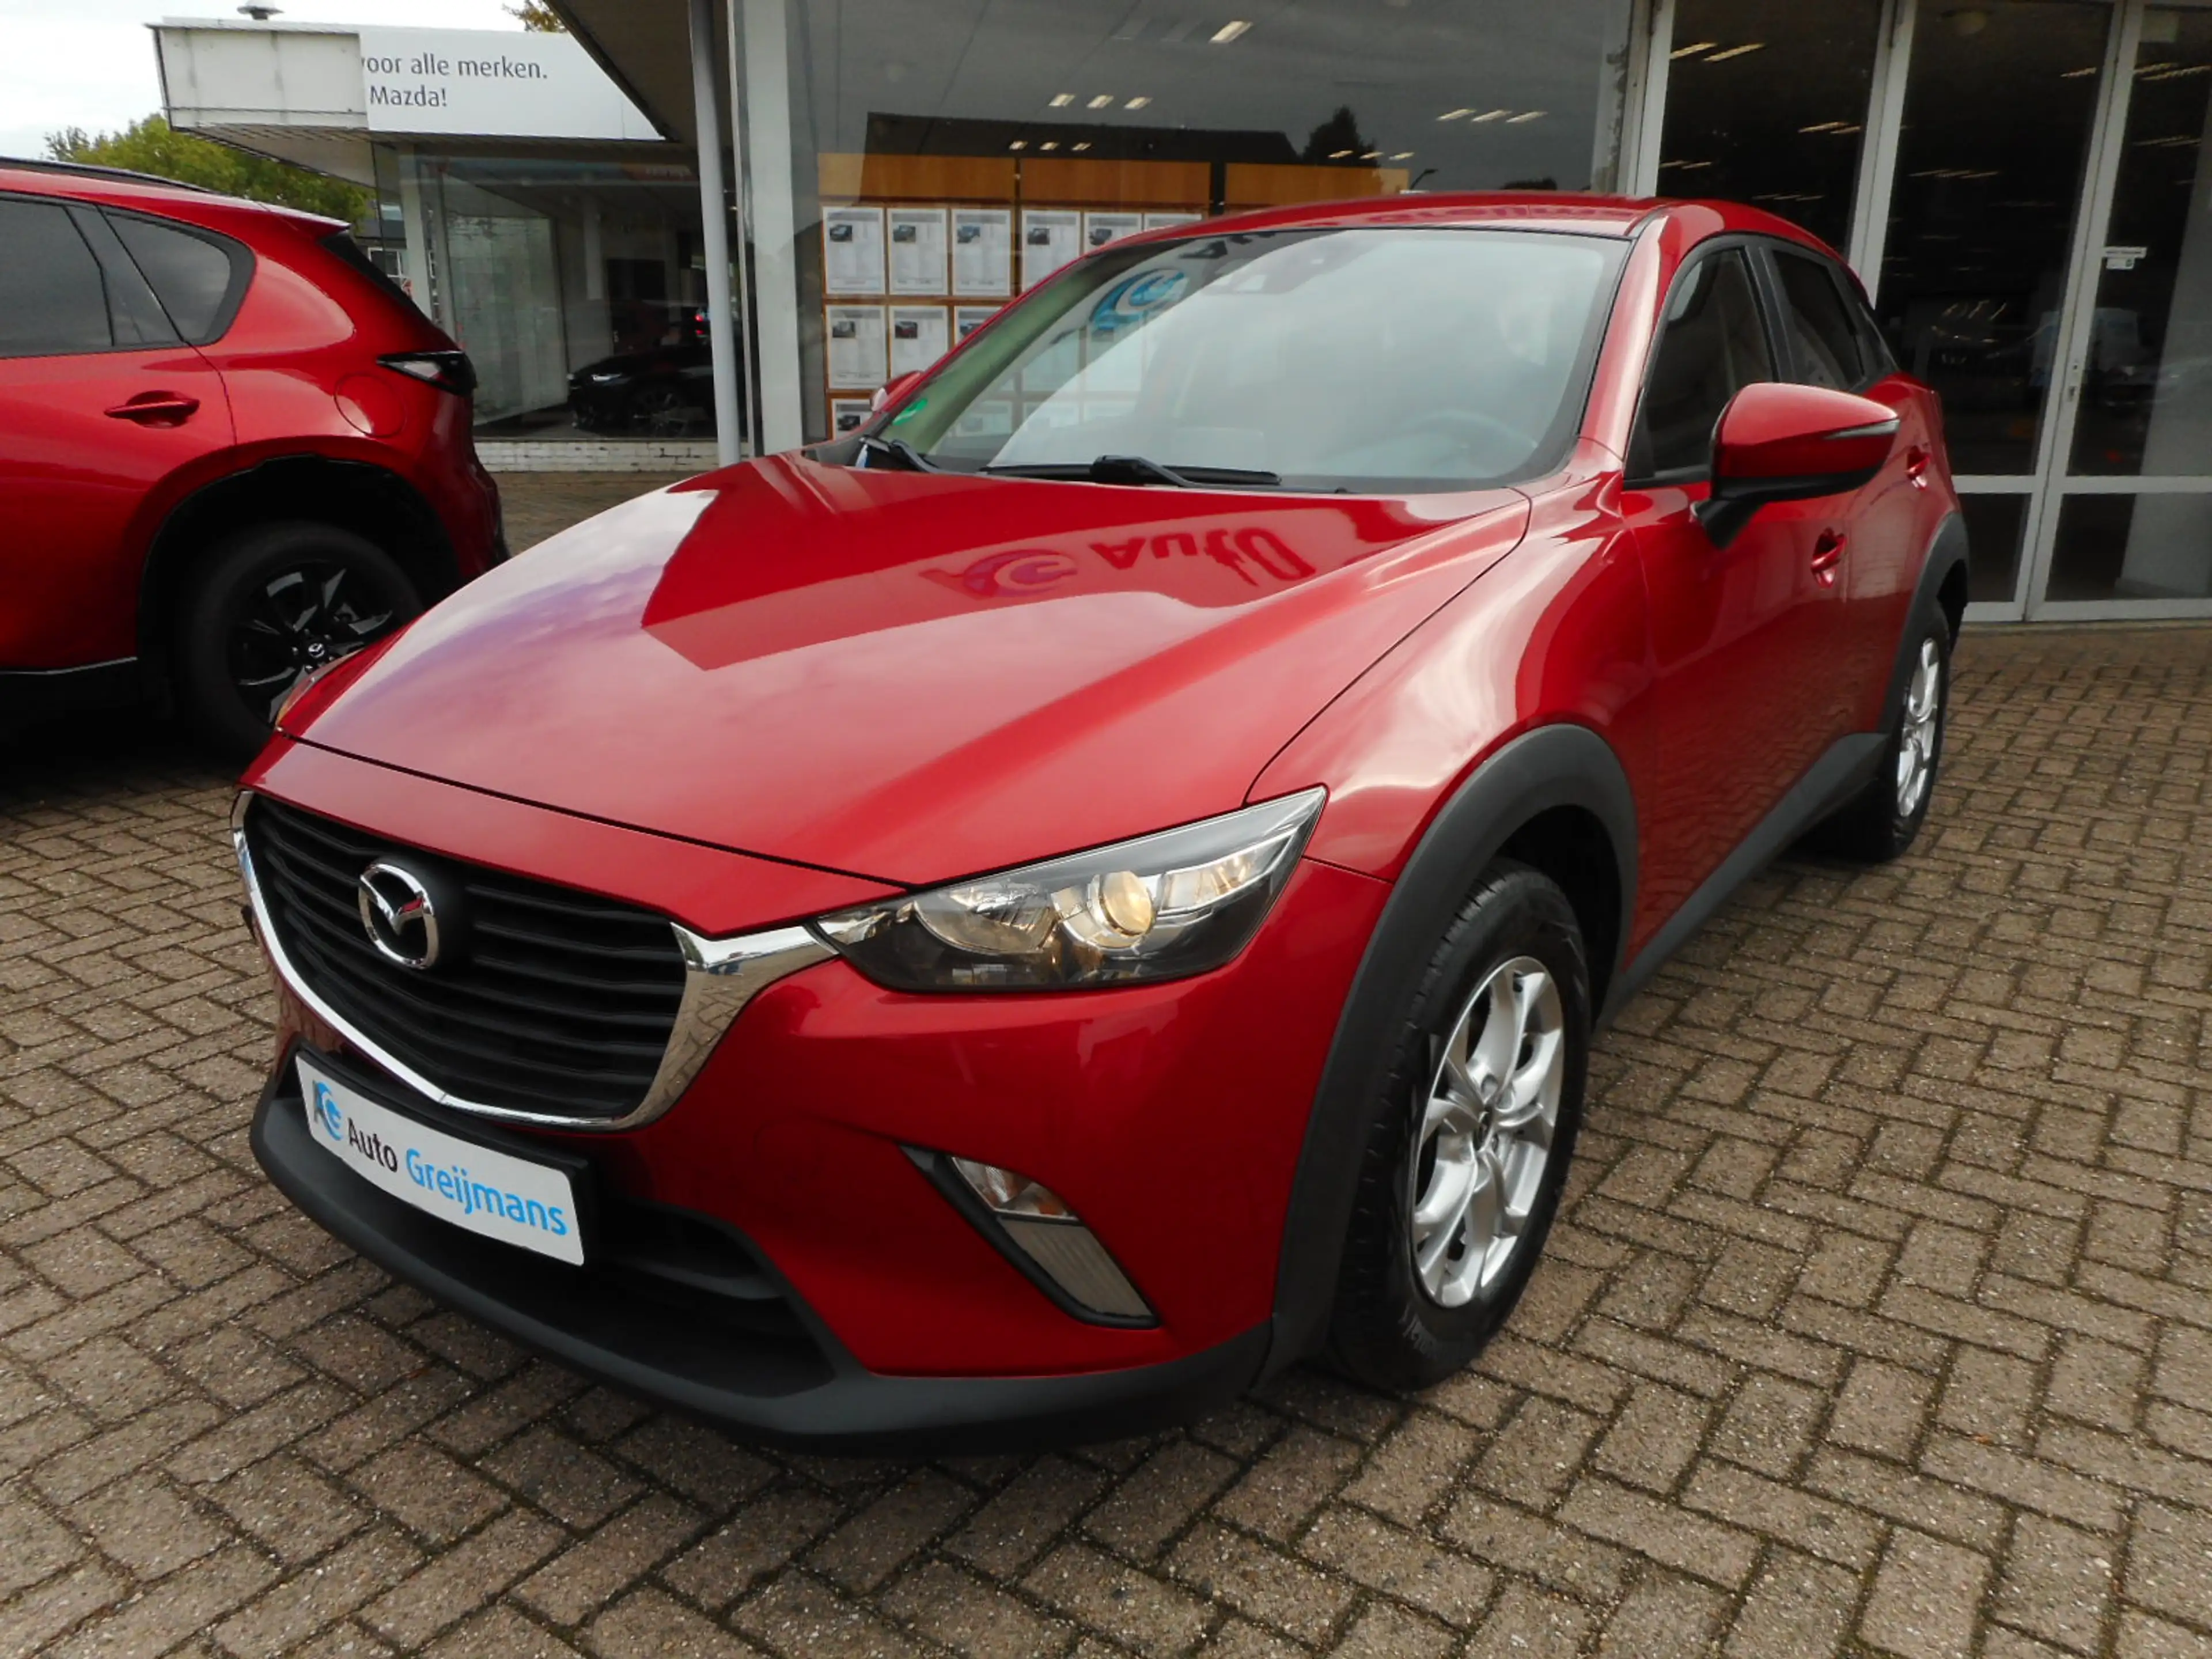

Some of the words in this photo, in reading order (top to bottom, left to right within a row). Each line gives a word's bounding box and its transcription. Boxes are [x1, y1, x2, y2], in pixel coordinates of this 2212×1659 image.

[411, 52, 449, 76] alle
[458, 56, 548, 79] merken.
[370, 85, 447, 107] Mazda!
[347, 1118, 398, 1173] Auto
[406, 1148, 569, 1237] Greijmans
